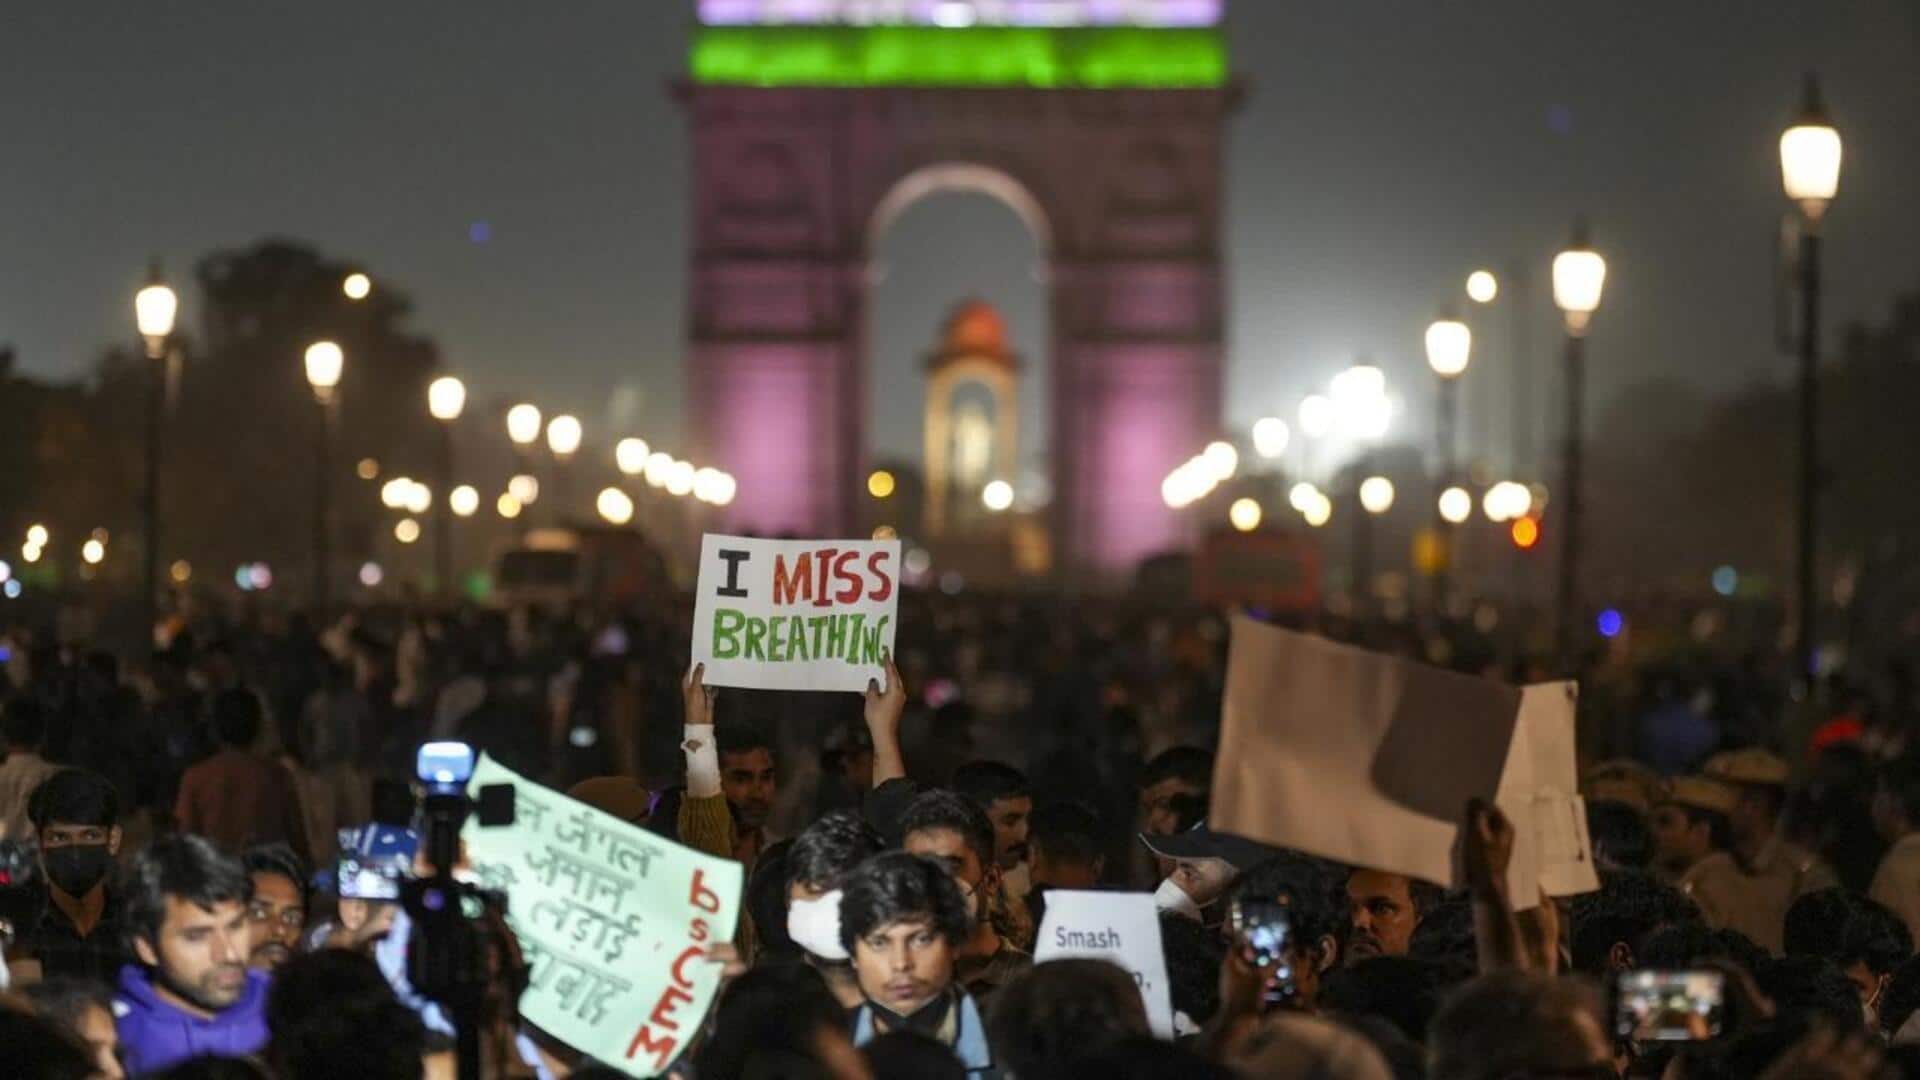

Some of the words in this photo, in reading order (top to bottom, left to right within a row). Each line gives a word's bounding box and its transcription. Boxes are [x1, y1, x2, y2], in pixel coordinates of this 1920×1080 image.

[717, 548, 751, 598] I
[772, 548, 893, 608] MISS
[711, 607, 890, 668] BREATHING
[1055, 925, 1122, 949] Smash
